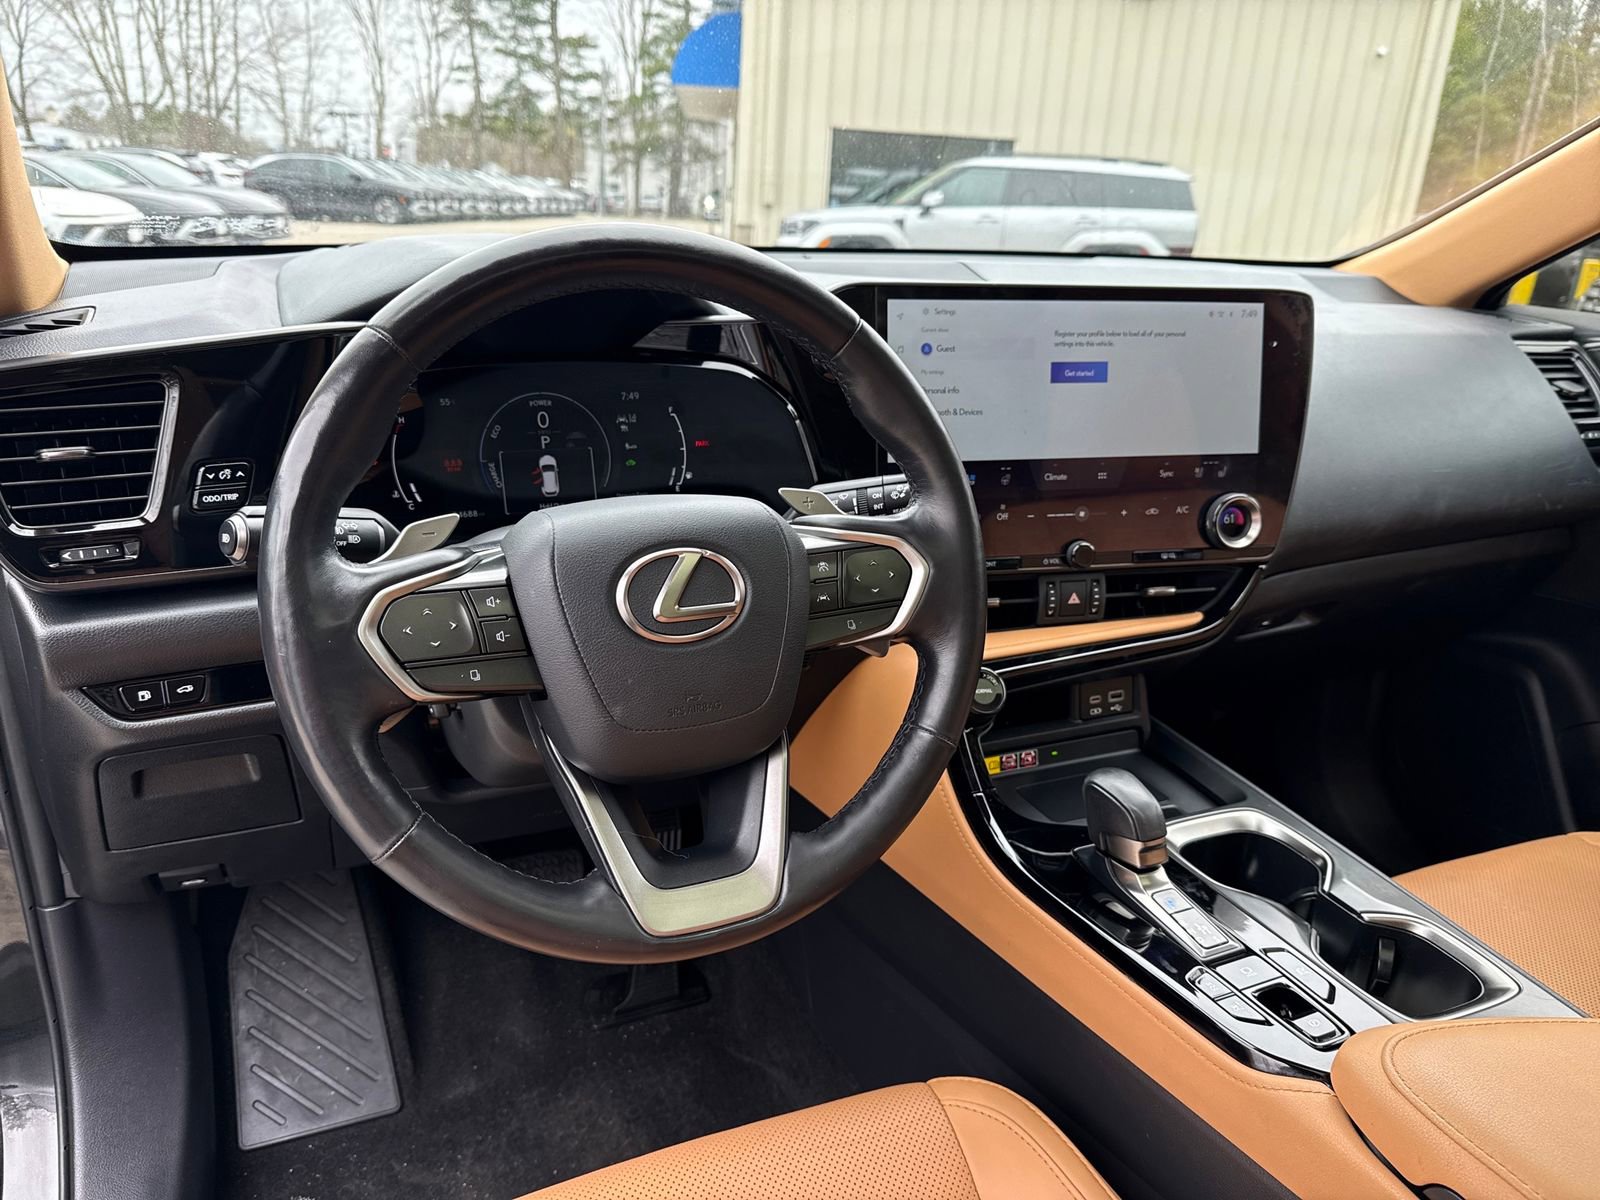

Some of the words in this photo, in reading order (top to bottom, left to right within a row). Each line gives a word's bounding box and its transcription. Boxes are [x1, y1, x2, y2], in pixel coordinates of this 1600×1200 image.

[934, 307, 956, 317] Settings
[1241, 309, 1258, 319] 7:49
[1054, 330, 1075, 339] Register
[1089, 330, 1105, 339] profile
[1106, 330, 1122, 338] below
[1166, 330, 1186, 339] personal
[936, 344, 956, 353] Guest
[1054, 341, 1074, 349] settings
[1075, 340, 1084, 348] into
[1064, 369, 1075, 378] Get
[1075, 369, 1094, 378] started
[947, 386, 960, 394] info
[621, 391, 640, 400] 7:49
[952, 408, 958, 416] &
[959, 407, 983, 417] Devices
[540, 436, 550, 449] P
[1043, 472, 1068, 482] Climate
[1159, 469, 1175, 480] Sync
[202, 492, 239, 503] ODO/TRIP
[873, 503, 884, 511] INT
[1175, 505, 1190, 514] A/C
[996, 512, 1009, 521] Off
[1223, 513, 1235, 524] 61
[667, 706, 686, 718] SRS
[687, 703, 723, 715] AIRBAG
